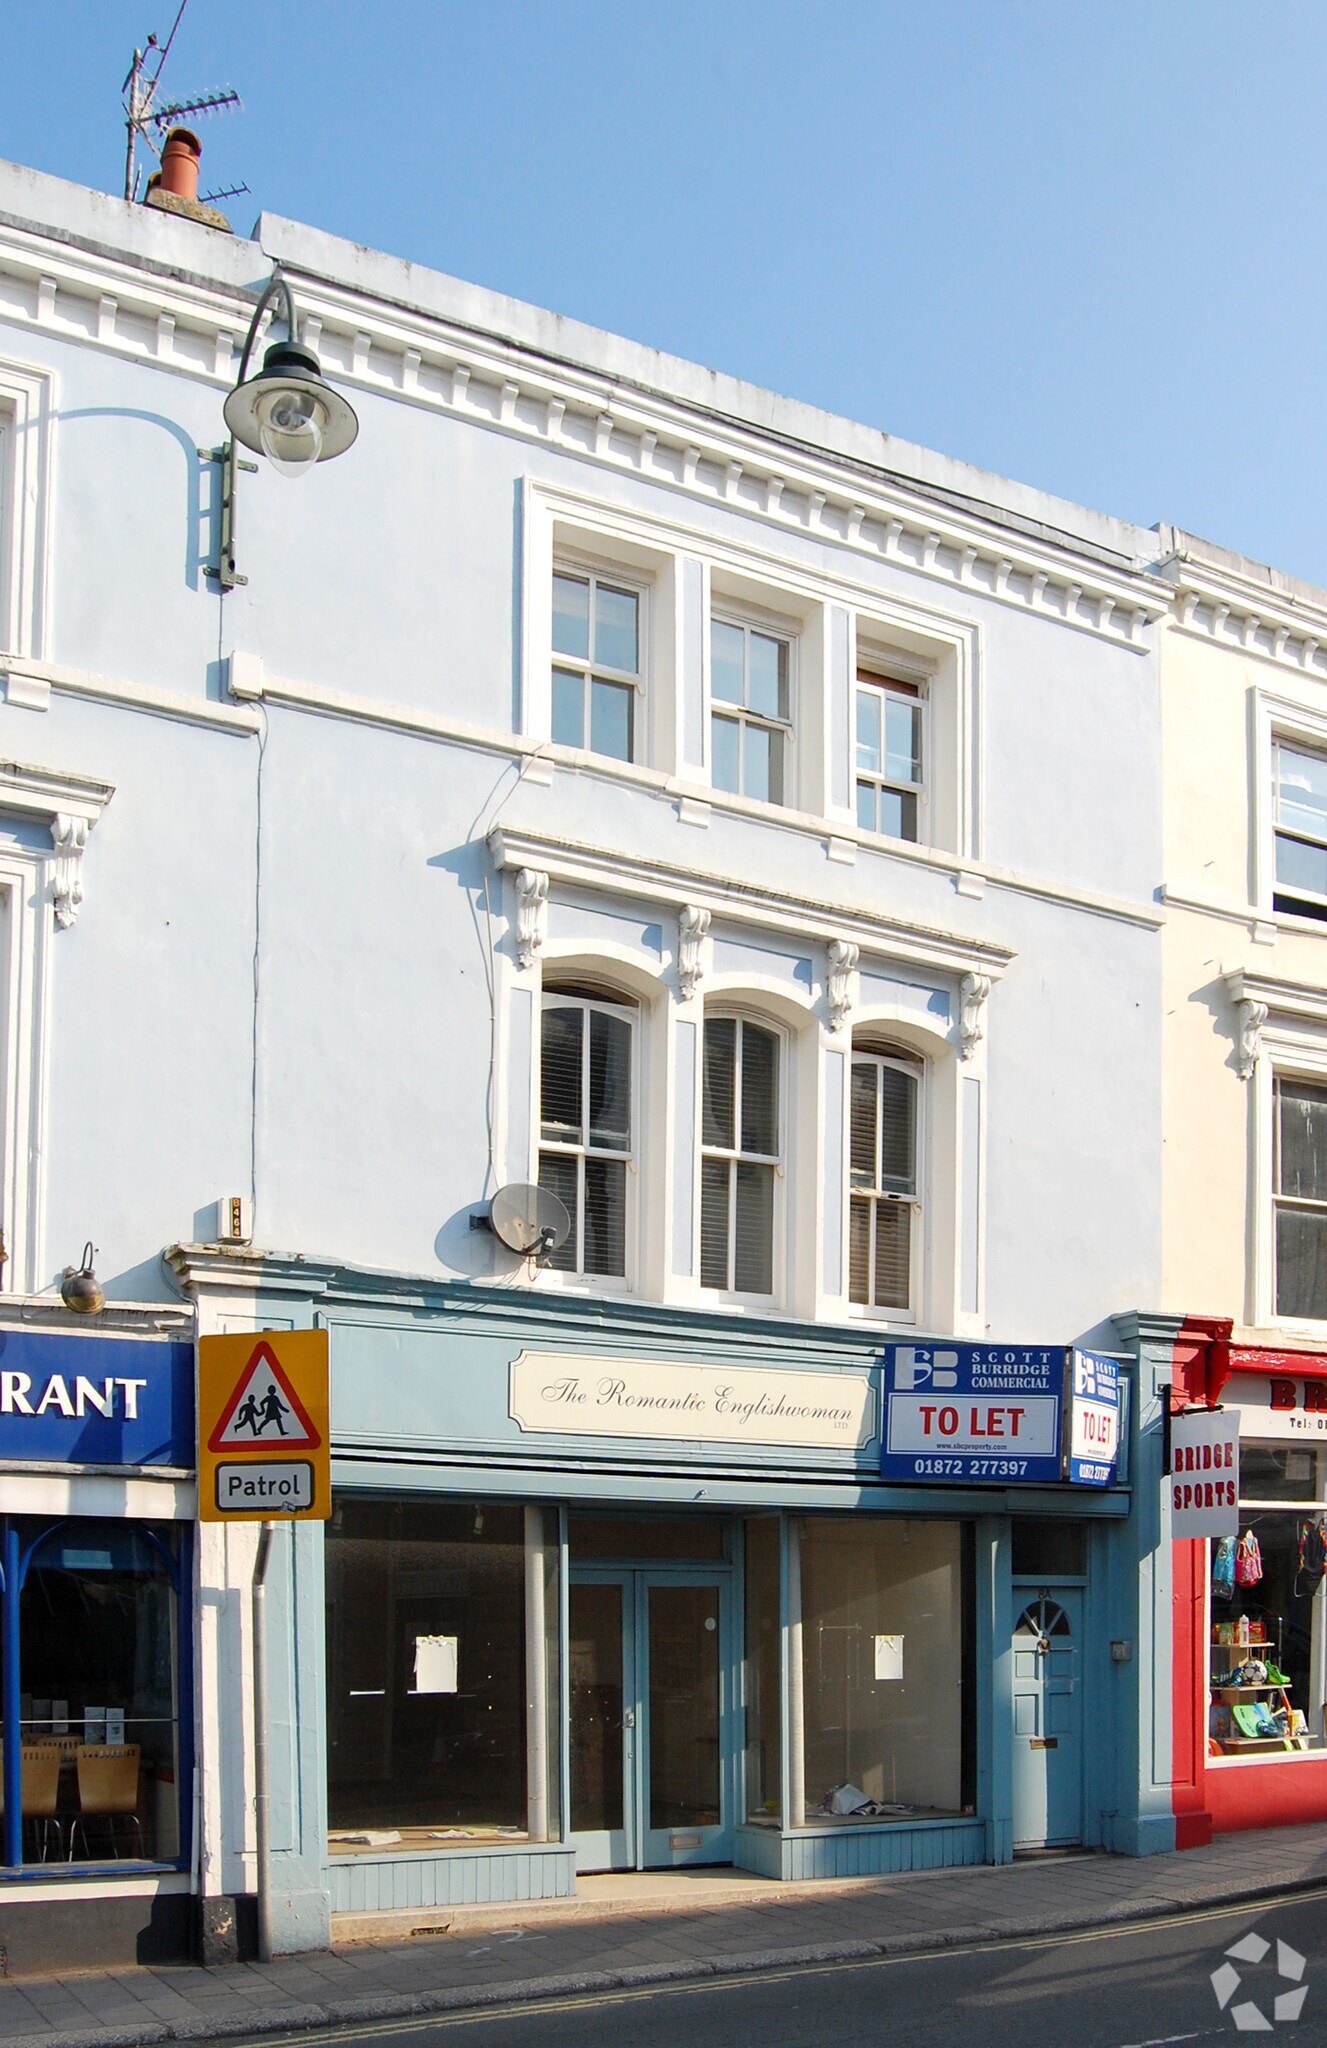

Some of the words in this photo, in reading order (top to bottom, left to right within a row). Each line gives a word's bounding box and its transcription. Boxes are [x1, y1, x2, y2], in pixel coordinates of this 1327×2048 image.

[971, 1351, 1050, 1363] SCOTT
[971, 1364, 1050, 1375] BURRIDGE
[971, 1376, 1050, 1389] COMMERCIAL
[1, 1371, 147, 1419] RANT
[541, 1377, 587, 1404] The
[596, 1376, 706, 1412] Romantic
[714, 1384, 853, 1425] Englishwoman
[919, 1406, 959, 1436] TO
[969, 1407, 1025, 1437] LET
[1083, 1412, 1096, 1441] TO
[1097, 1414, 1112, 1444] LET
[1290, 1417, 1311, 1429] Tel:
[936, 1443, 1007, 1451] www.sbcproperty.com
[1174, 1442, 1233, 1472] BRIDGE
[914, 1459, 962, 1475] 01872
[969, 1459, 1028, 1476] 277397
[228, 1474, 300, 1497] Patrol
[1173, 1480, 1235, 1510] SPORTS
